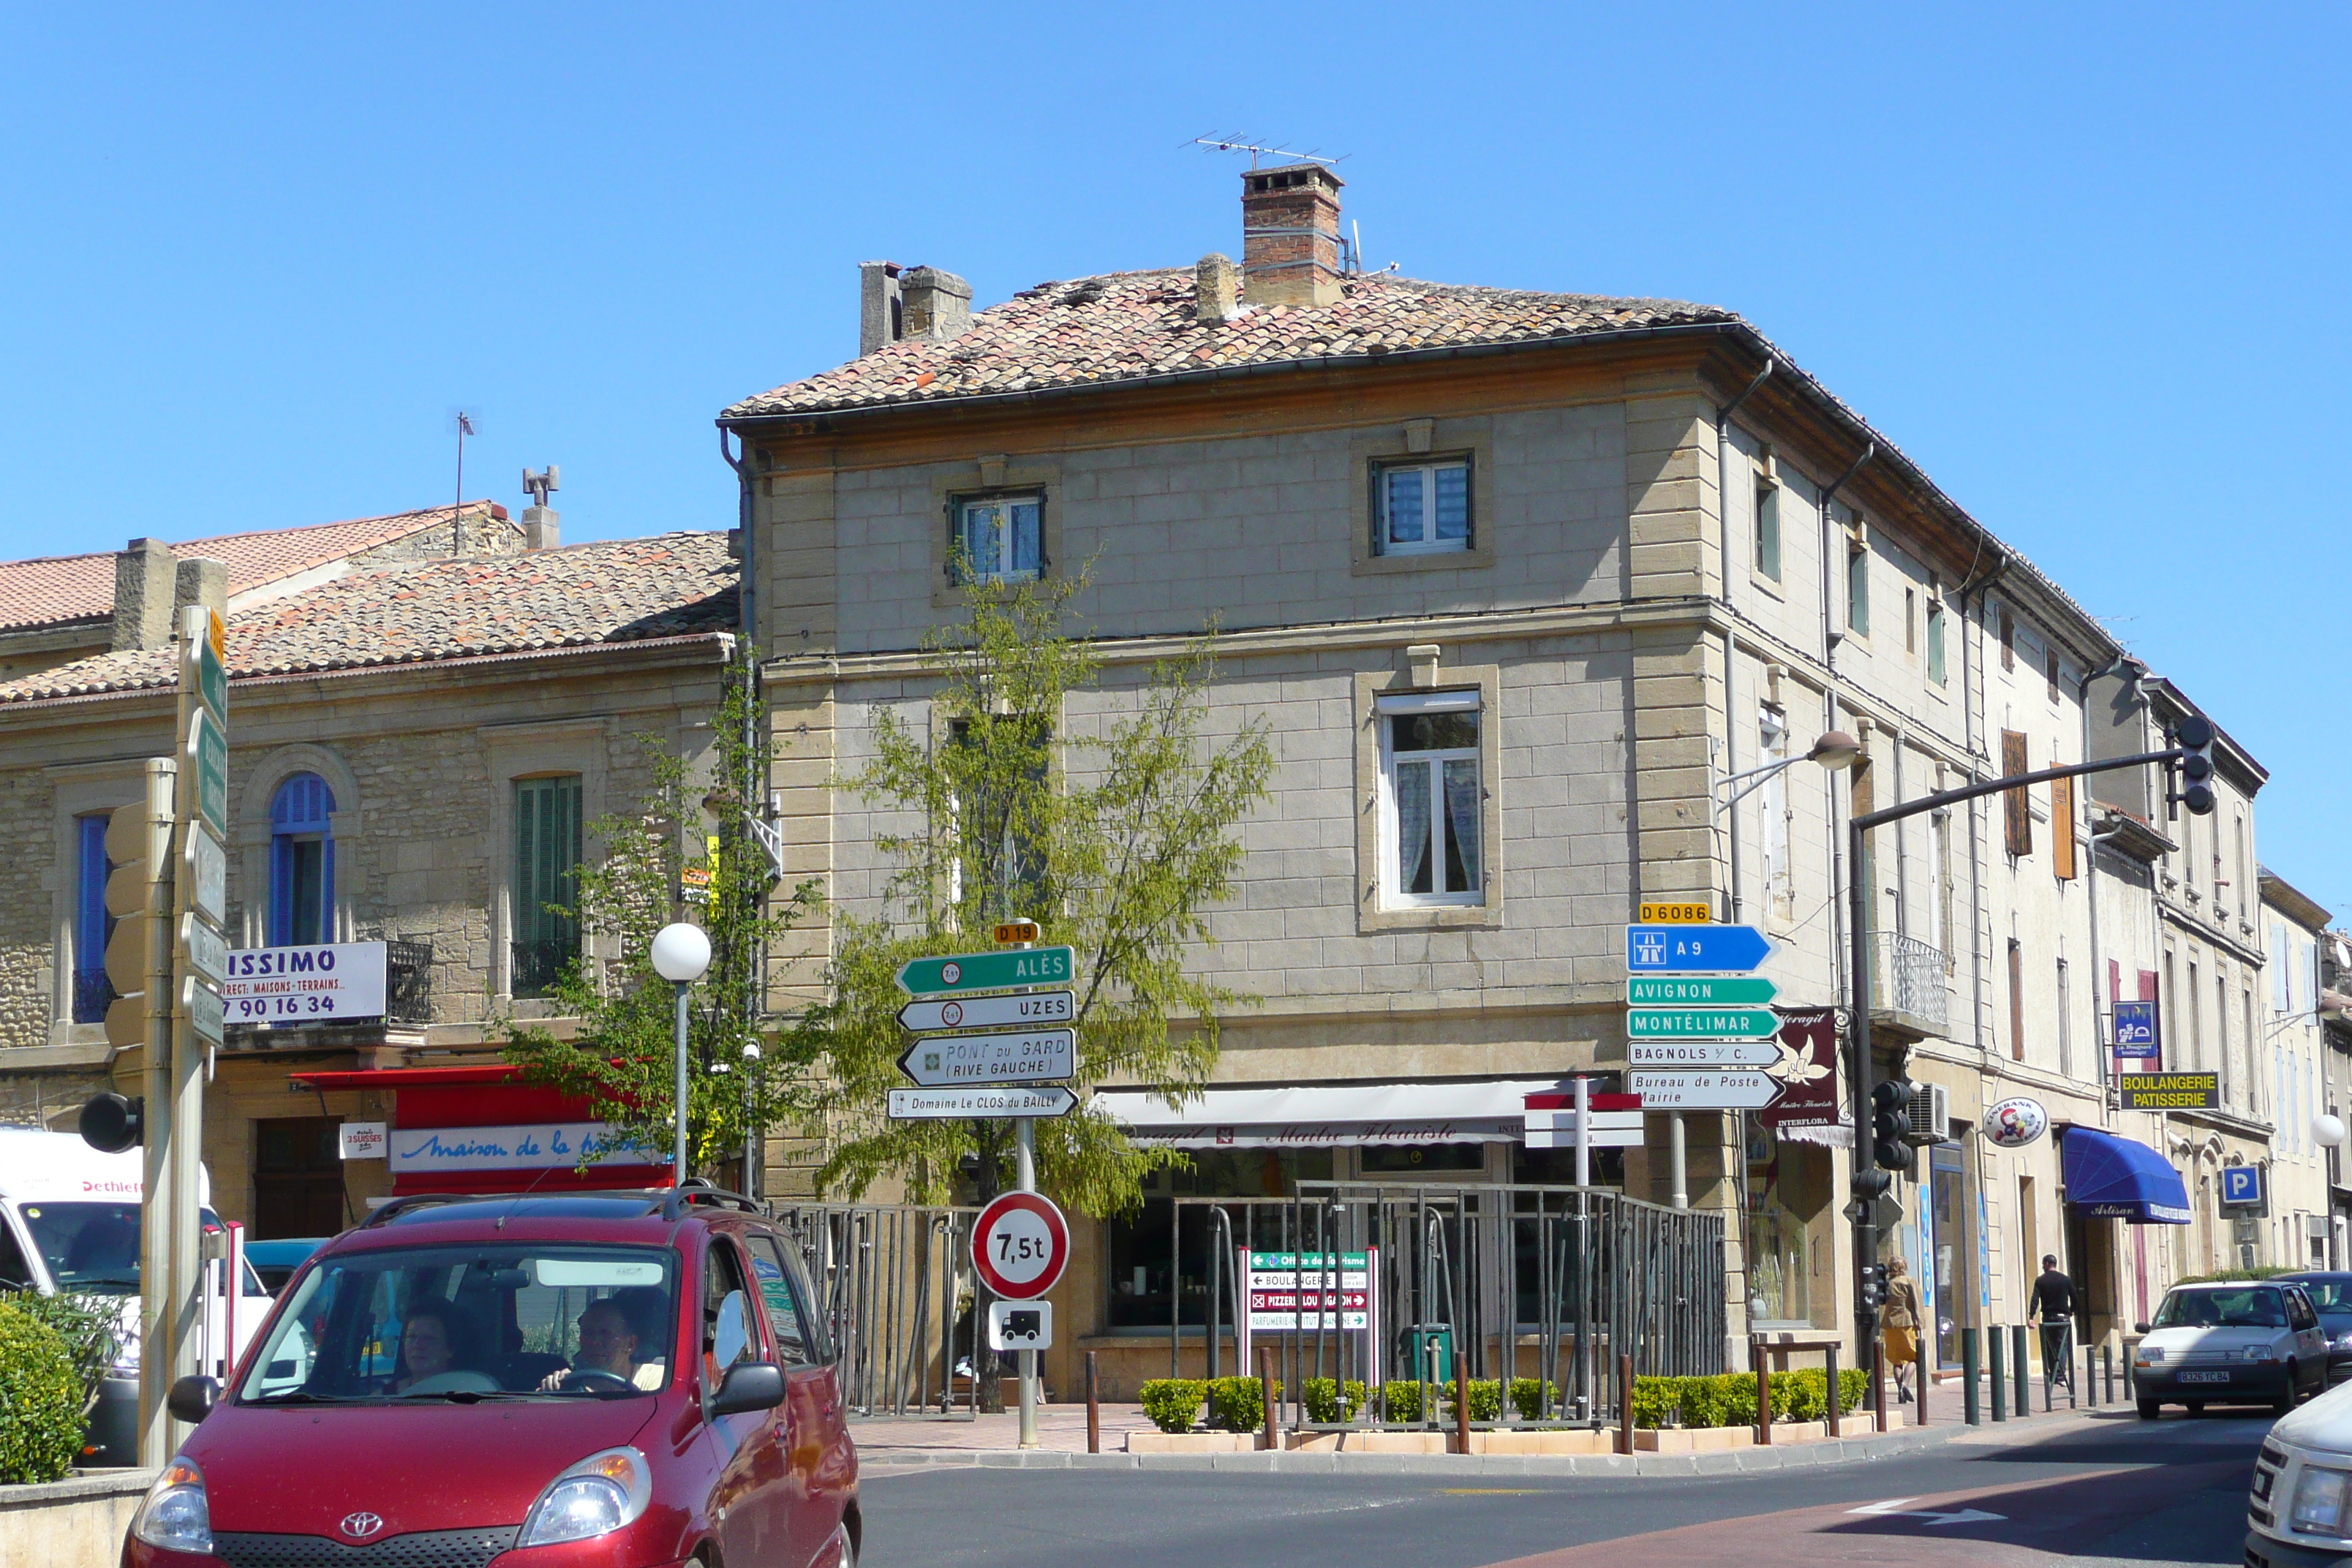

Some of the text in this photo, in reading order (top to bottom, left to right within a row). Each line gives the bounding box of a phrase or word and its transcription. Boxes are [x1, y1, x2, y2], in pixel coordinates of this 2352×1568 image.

[1642, 907, 1706, 919] D 6086
[1000, 926, 1031, 941] D 19
[1676, 942, 1702, 955] A 9
[1016, 954, 1063, 976] ALÈS
[1635, 984, 1712, 998] AVIGNON
[240, 999, 266, 1017] 90
[276, 998, 298, 1014] 16
[307, 995, 334, 1012] 34
[1020, 1000, 1065, 1015] UZES
[1635, 1014, 1749, 1030] MONTÉLIMAR
[947, 1040, 1065, 1060] PONT DU GARD
[1635, 1049, 1706, 1059] BAGNOLS
[946, 1064, 983, 1077] (RIVE
[1636, 1076, 1759, 1087] Bureau de Poste
[2123, 1076, 2215, 1090] BOULANGERIE
[912, 1096, 1058, 1109] Domaine Le CLOS du BAILLY
[1638, 1092, 1681, 1102] Mairie
[2133, 1093, 2206, 1107] PATISSERIE
[1778, 1117, 1828, 1126] INTERFLORA
[402, 1134, 508, 1158] maison
[516, 1134, 540, 1156] de
[550, 1130, 570, 1155] la
[1303, 1295, 1318, 1305] LOU
